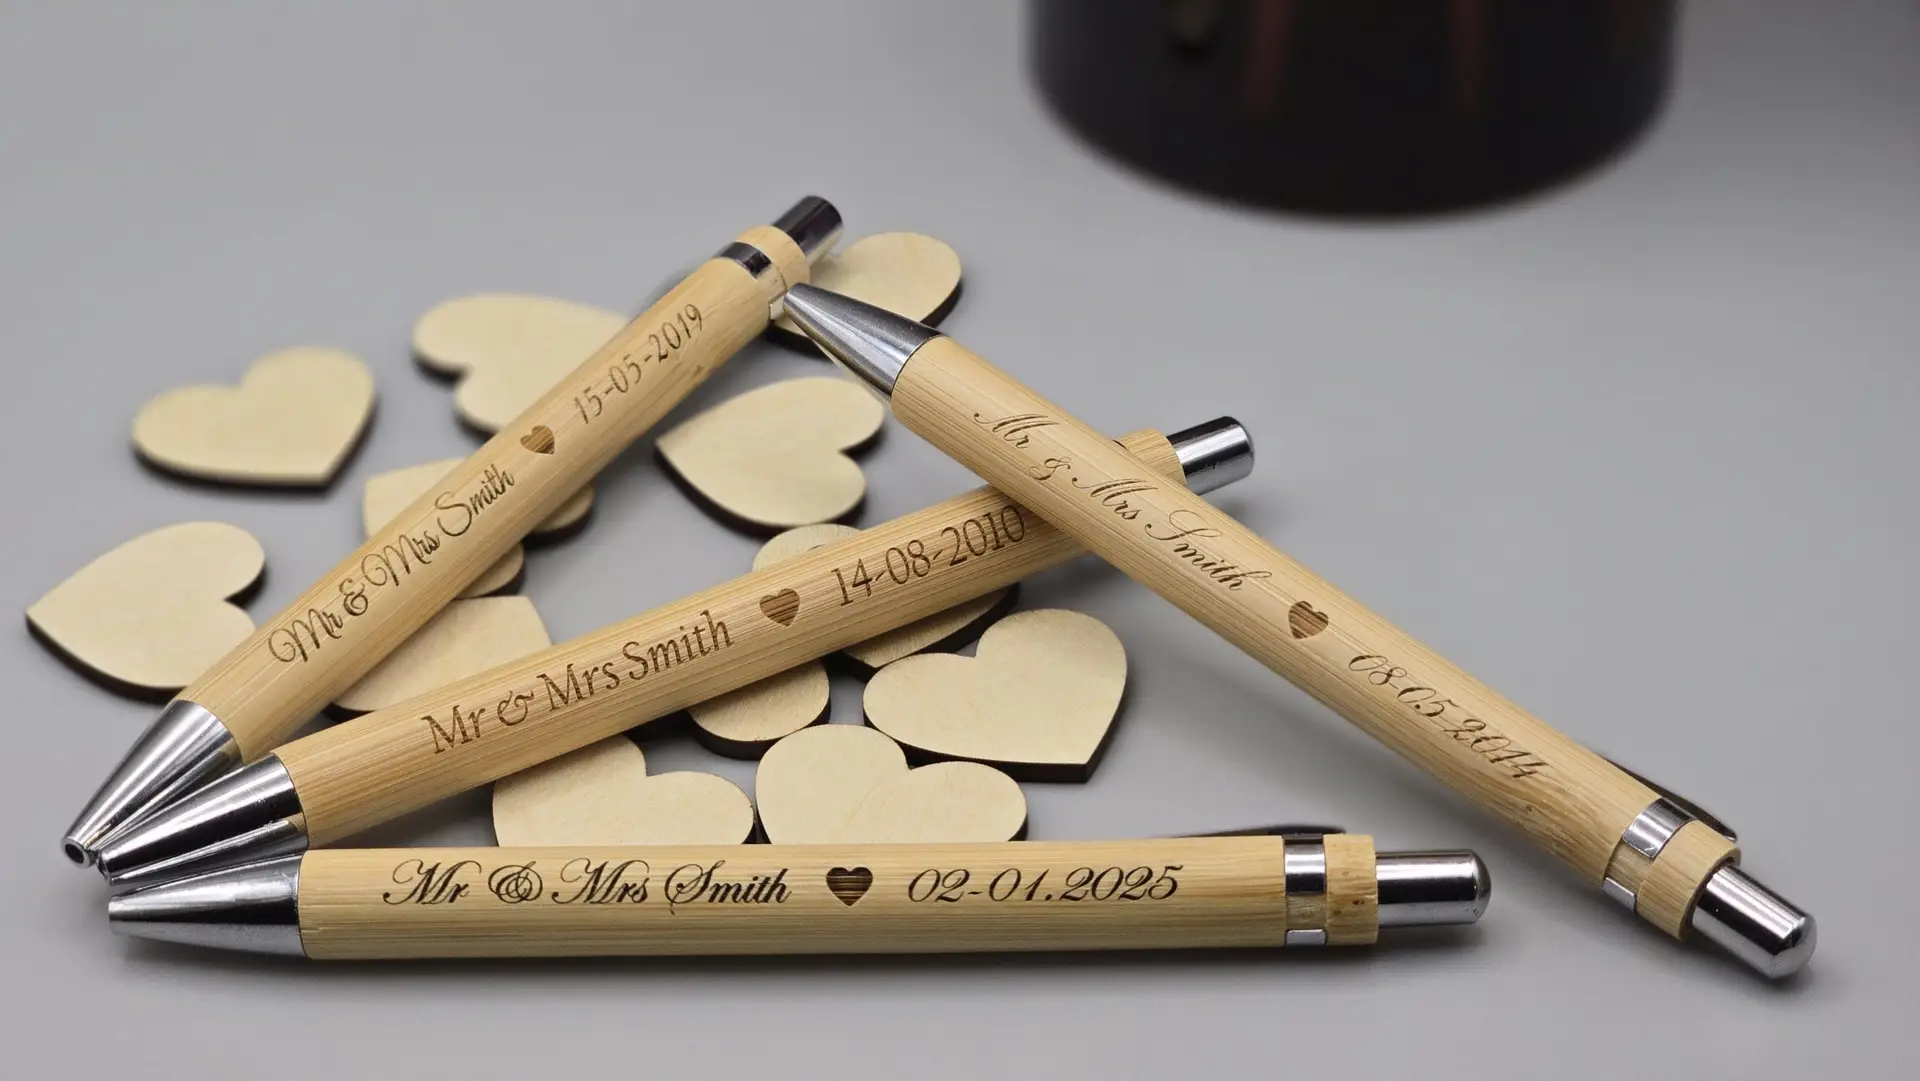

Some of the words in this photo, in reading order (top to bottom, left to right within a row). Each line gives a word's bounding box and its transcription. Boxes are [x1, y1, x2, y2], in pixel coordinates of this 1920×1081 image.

[268, 607, 344, 664] Mr
[338, 578, 369, 616] &
[361, 530, 441, 588] Mrs
[434, 463, 515, 537] Smith
[574, 303, 703, 424] 15-05-2019
[421, 705, 486, 754] Mr
[498, 690, 535, 726] &
[536, 662, 621, 711] Mrs
[623, 610, 734, 681] Smith
[831, 505, 1026, 606] 14-08-2010
[973, 411, 1058, 450] Mr
[1028, 457, 1071, 482] &
[1071, 477, 1158, 522] Mrs
[1145, 509, 1272, 592] Smith
[1348, 654, 1550, 780] 08-05-2014
[383, 858, 482, 905] Mr
[488, 860, 544, 904] &
[551, 858, 649, 905] Mrs
[664, 859, 792, 915] Smith
[908, 865, 1183, 904] 02-01.2025
